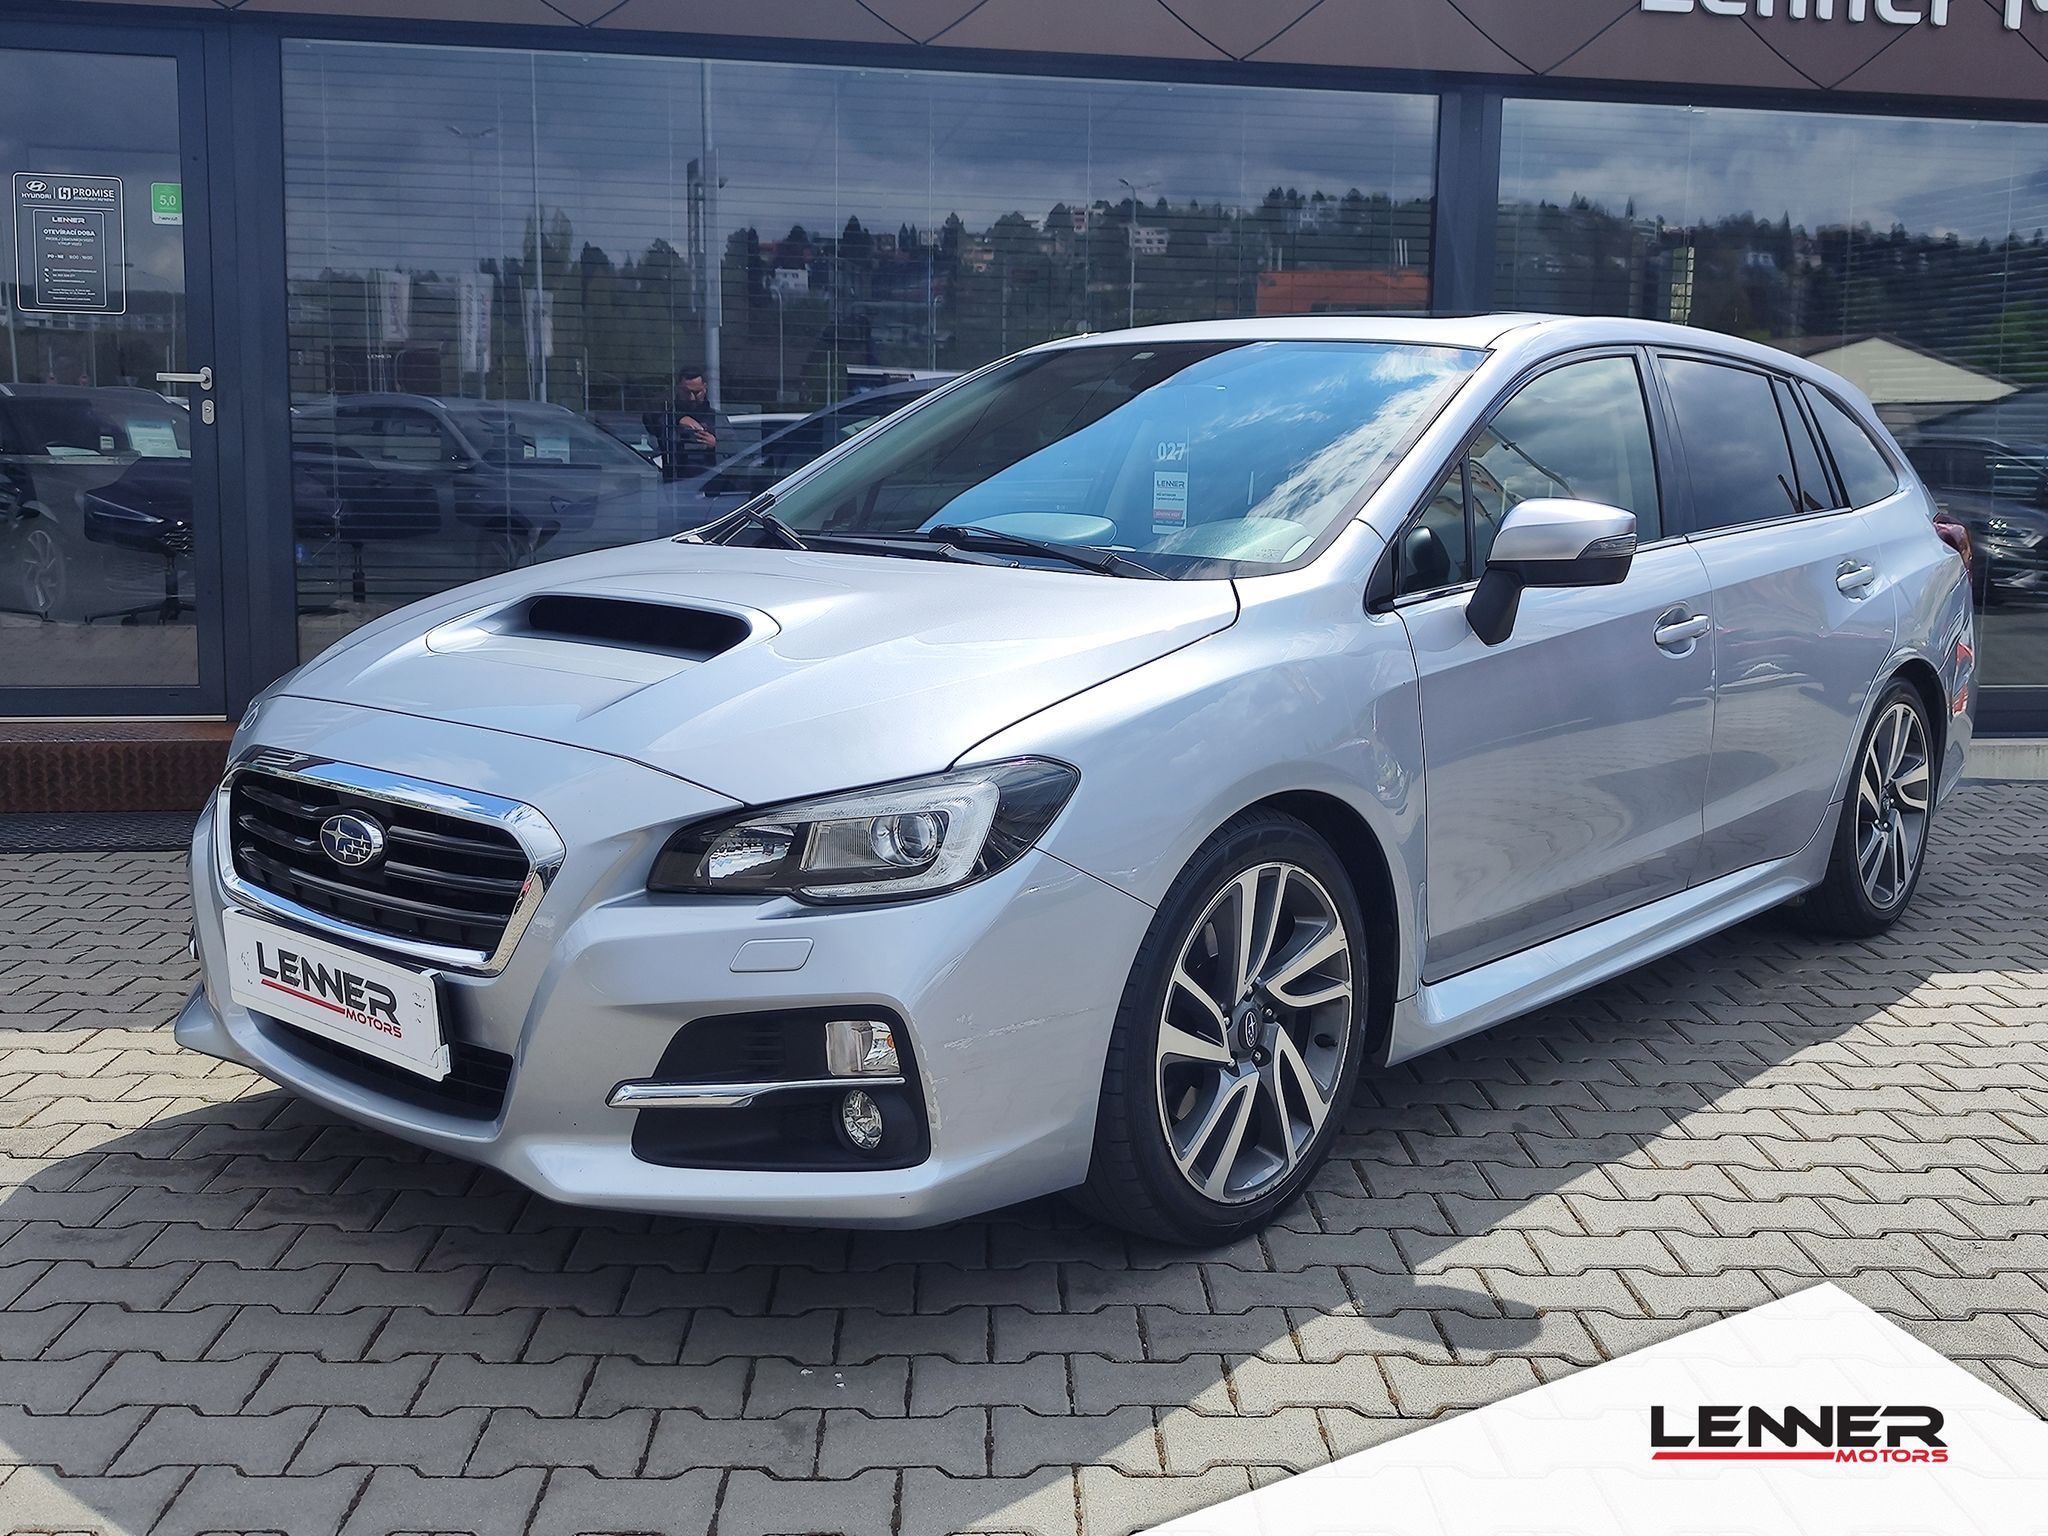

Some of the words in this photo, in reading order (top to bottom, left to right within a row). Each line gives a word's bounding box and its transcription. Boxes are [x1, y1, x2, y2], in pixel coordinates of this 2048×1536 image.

[73, 188, 115, 198] PROMISE
[160, 194, 176, 206] 5,0
[52, 216, 86, 224] LENNER
[1157, 441, 1186, 461] 027
[1156, 480, 1185, 489] LENNER
[256, 940, 401, 1026] LENNER
[345, 1008, 402, 1039] MOTORS
